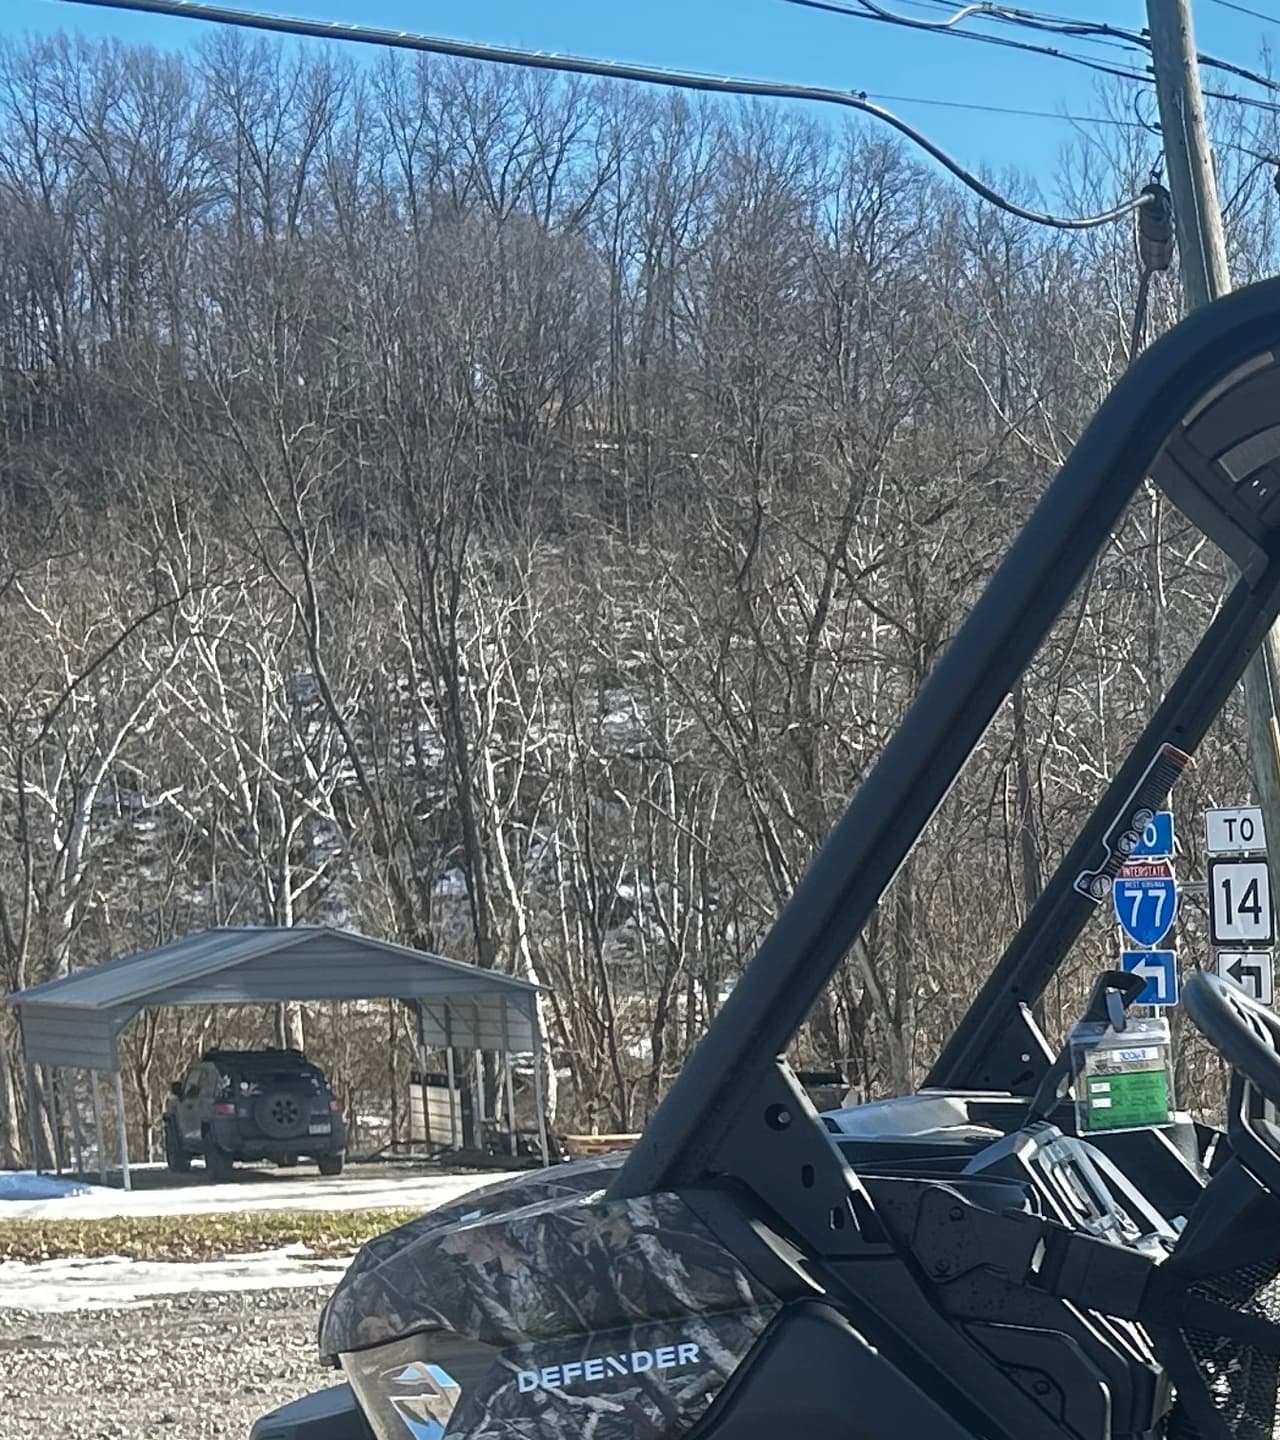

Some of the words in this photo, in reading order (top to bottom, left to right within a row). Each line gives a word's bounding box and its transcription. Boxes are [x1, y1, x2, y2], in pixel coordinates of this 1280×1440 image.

[1223, 818, 1255, 842] TO
[1122, 865, 1167, 878] INTERSTATE
[1124, 888, 1167, 928] 77
[1221, 878, 1263, 925] 14
[516, 1342, 701, 1393] DEFENDER
